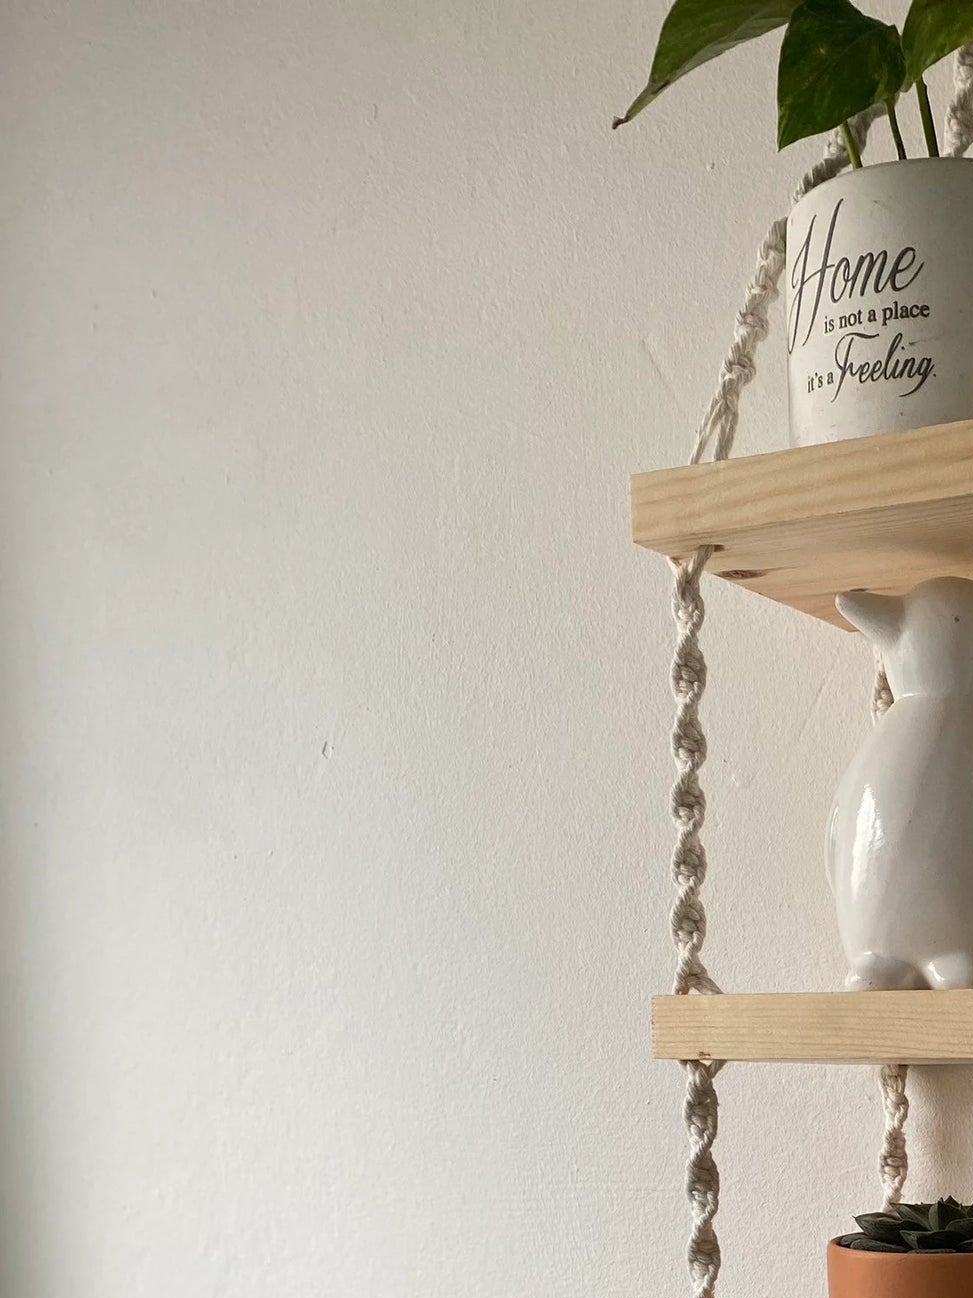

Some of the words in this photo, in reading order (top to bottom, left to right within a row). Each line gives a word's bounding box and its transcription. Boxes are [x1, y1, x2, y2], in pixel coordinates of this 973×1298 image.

[787, 198, 924, 355] Home
[823, 315, 835, 335] is
[838, 308, 863, 330] not
[867, 307, 877, 323] a
[881, 300, 931, 326] place
[806, 371, 824, 394] it's
[827, 371, 835, 385] a
